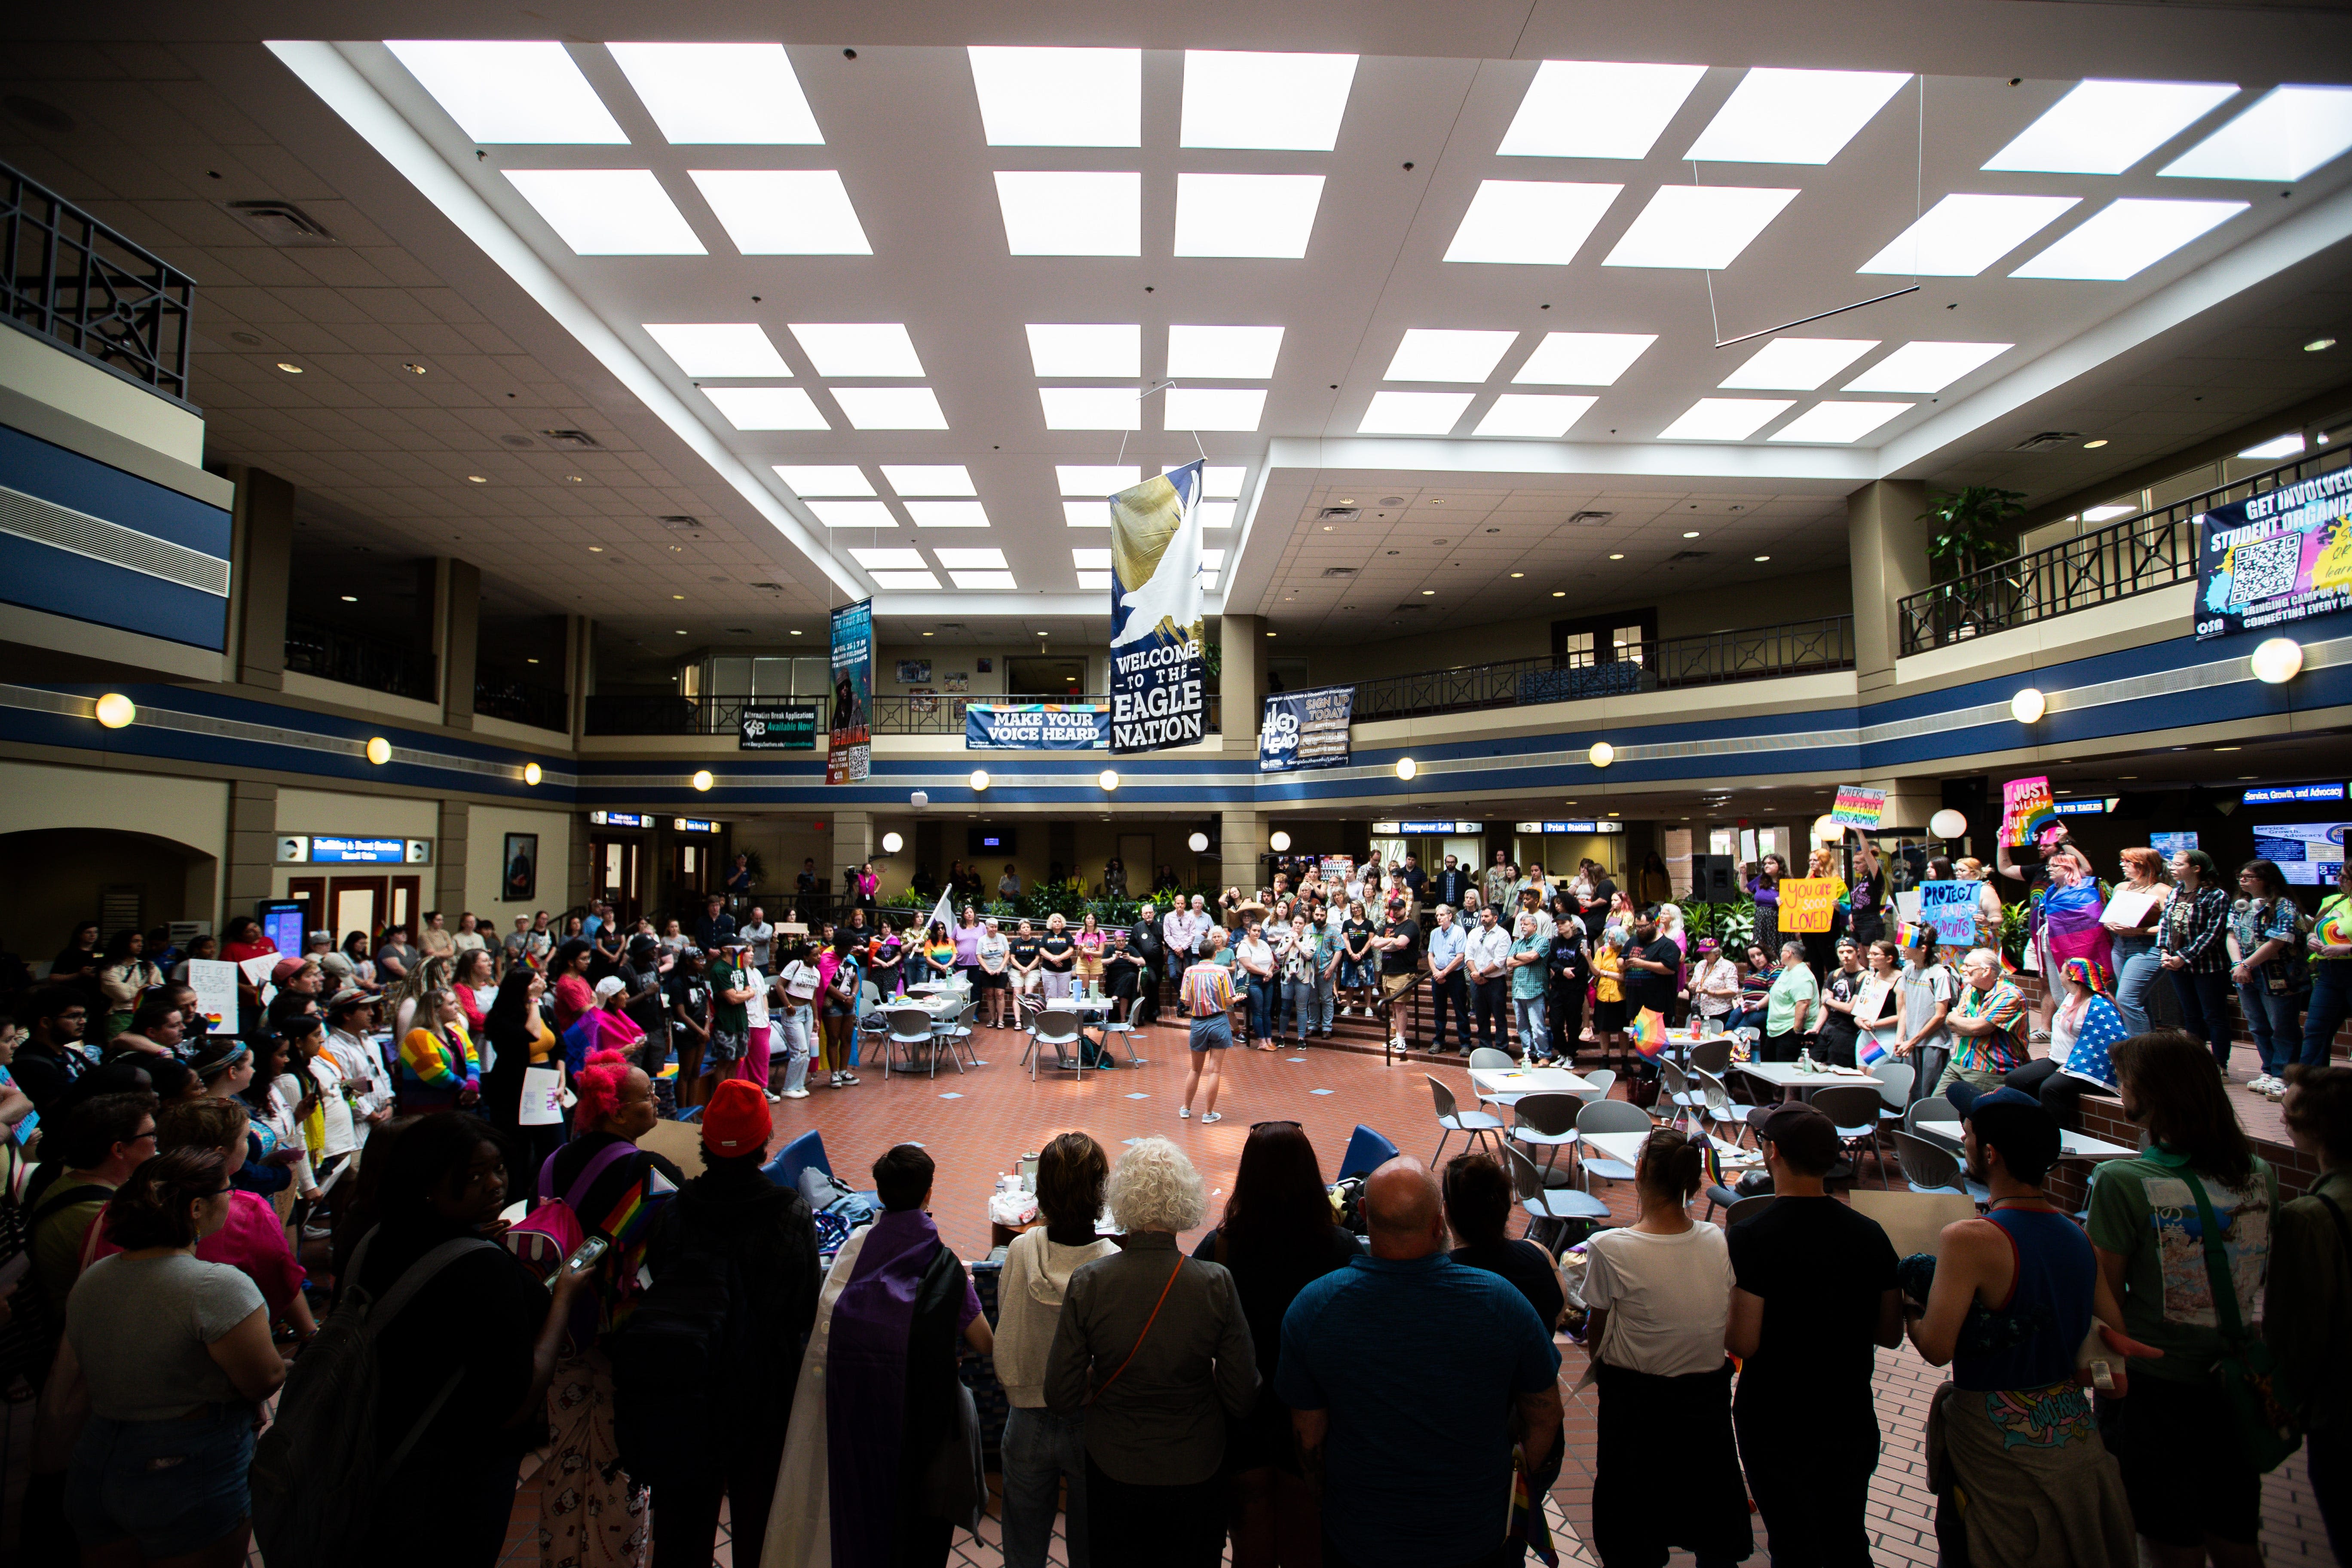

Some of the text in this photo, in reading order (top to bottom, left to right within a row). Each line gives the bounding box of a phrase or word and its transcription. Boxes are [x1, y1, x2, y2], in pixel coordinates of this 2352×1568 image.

[2245, 493, 2275, 520] GET
[2210, 515, 2279, 552] STUDENT
[2242, 583, 2350, 617] BRINGING CAMPUS TO
[2243, 605, 2306, 628] CONNECTING
[2306, 598, 2339, 615] EVERY
[2196, 618, 2224, 635] OSA
[1116, 639, 1200, 674] WELCOME
[1127, 664, 1187, 689] TO THE
[1114, 680, 1202, 722] EAGLE
[1306, 695, 1350, 710] SIGN UP
[785, 711, 814, 721] Applications
[994, 713, 1093, 726] MAKE YOUR
[1309, 707, 1346, 721] TODAY
[767, 721, 813, 731] Available Now!
[987, 727, 1100, 741] VOICE HEARD
[1114, 713, 1201, 748] NATION
[1300, 746, 1327, 754] ALTERNATIVE
[1839, 787, 1881, 800] WHERE IS
[2014, 781, 2048, 801] JUST
[2244, 787, 2343, 800] Service, Growth, and Advocacy
[1840, 799, 1880, 815] YOUR PRIDE
[1836, 811, 1879, 827] GS ADMIN?
[2009, 816, 2030, 830] BUT
[1403, 822, 1452, 833] Computer Lab
[1547, 823, 1591, 832] Print Station
[1924, 882, 1978, 907] PROTECT
[1932, 903, 1967, 919] TRANS
[1790, 910, 1828, 930] LOVED
